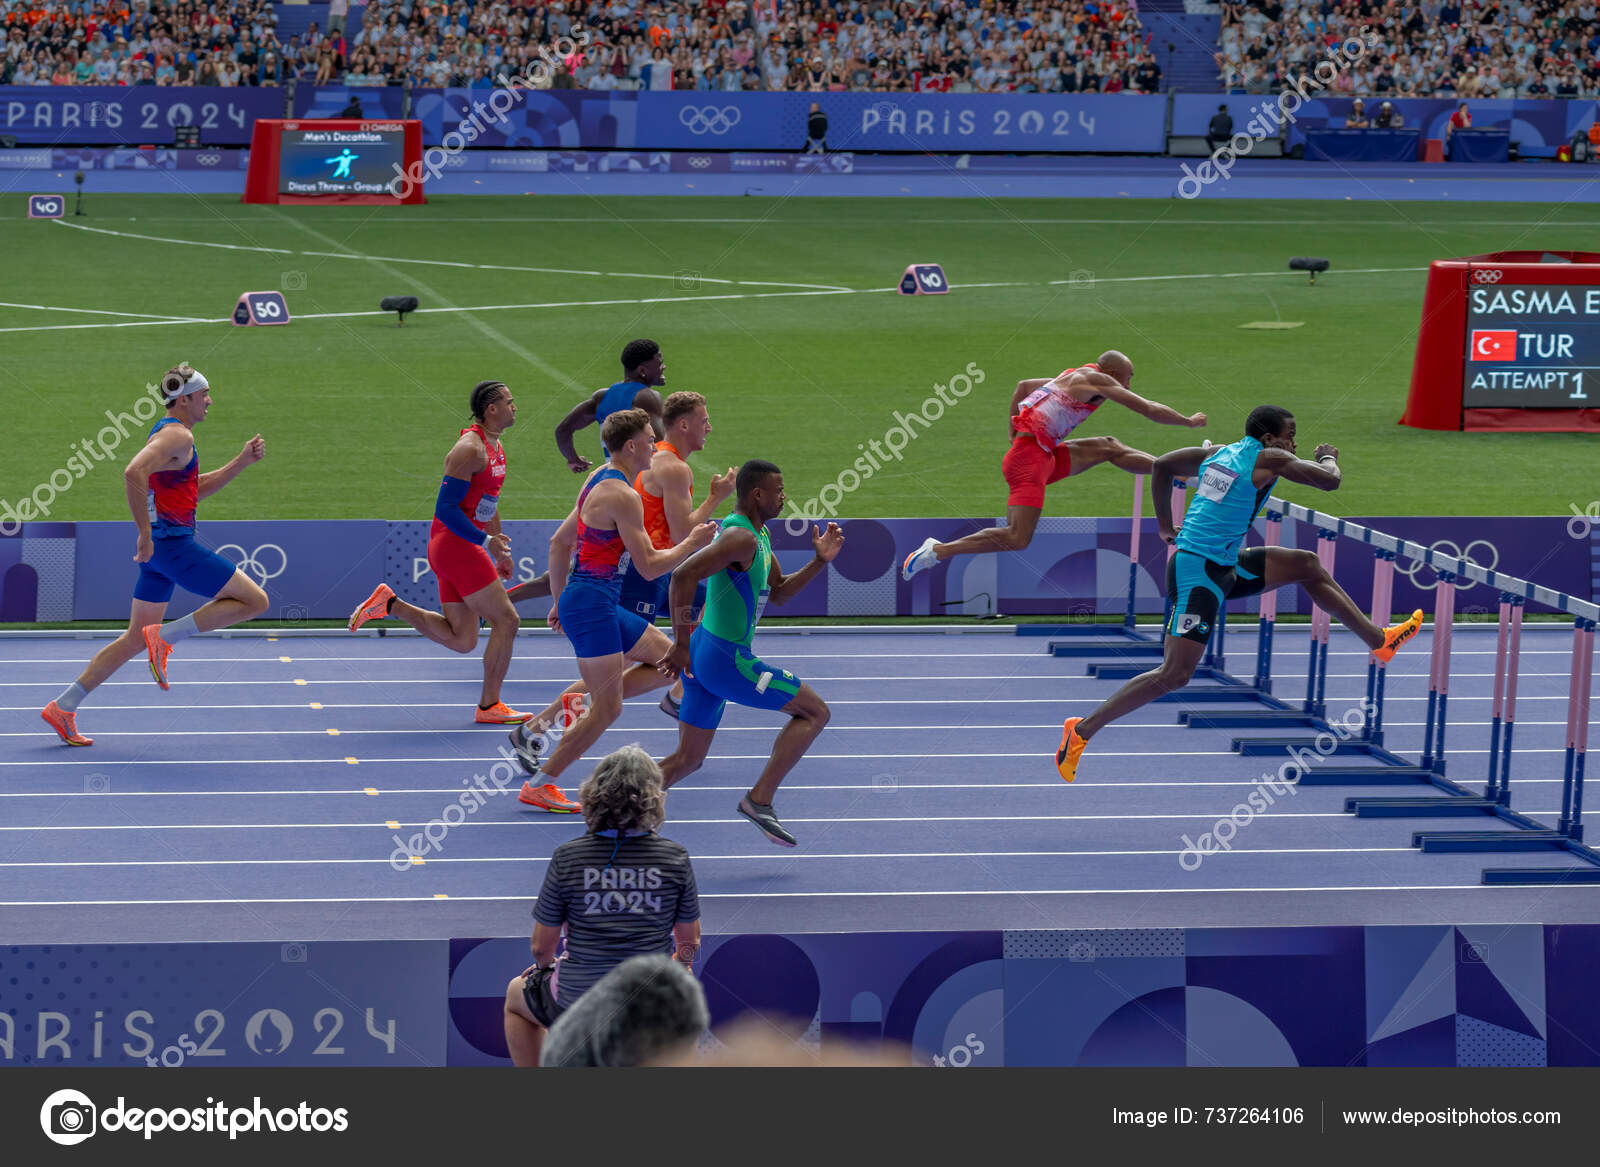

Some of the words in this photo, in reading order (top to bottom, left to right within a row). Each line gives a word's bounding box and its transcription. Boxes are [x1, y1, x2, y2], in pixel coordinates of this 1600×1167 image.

[141, 103, 245, 129] 2024
[993, 110, 1096, 135] 2024
[303, 132, 332, 142] Men's
[334, 131, 382, 142] Decathlon
[288, 182, 316, 191] Discus
[318, 182, 344, 191] Throw
[354, 182, 381, 193] Group
[36, 202, 58, 213] 40
[920, 273, 942, 287] 40
[256, 301, 281, 318] 50
[1472, 289, 1577, 314] SASMA
[1585, 290, 1600, 314] E
[1518, 334, 1574, 358] TUR
[1471, 372, 1569, 389] ATTEMPT
[1569, 372, 1588, 399] 1
[583, 891, 662, 915] 2024
[194, 1007, 397, 1056] 2024
